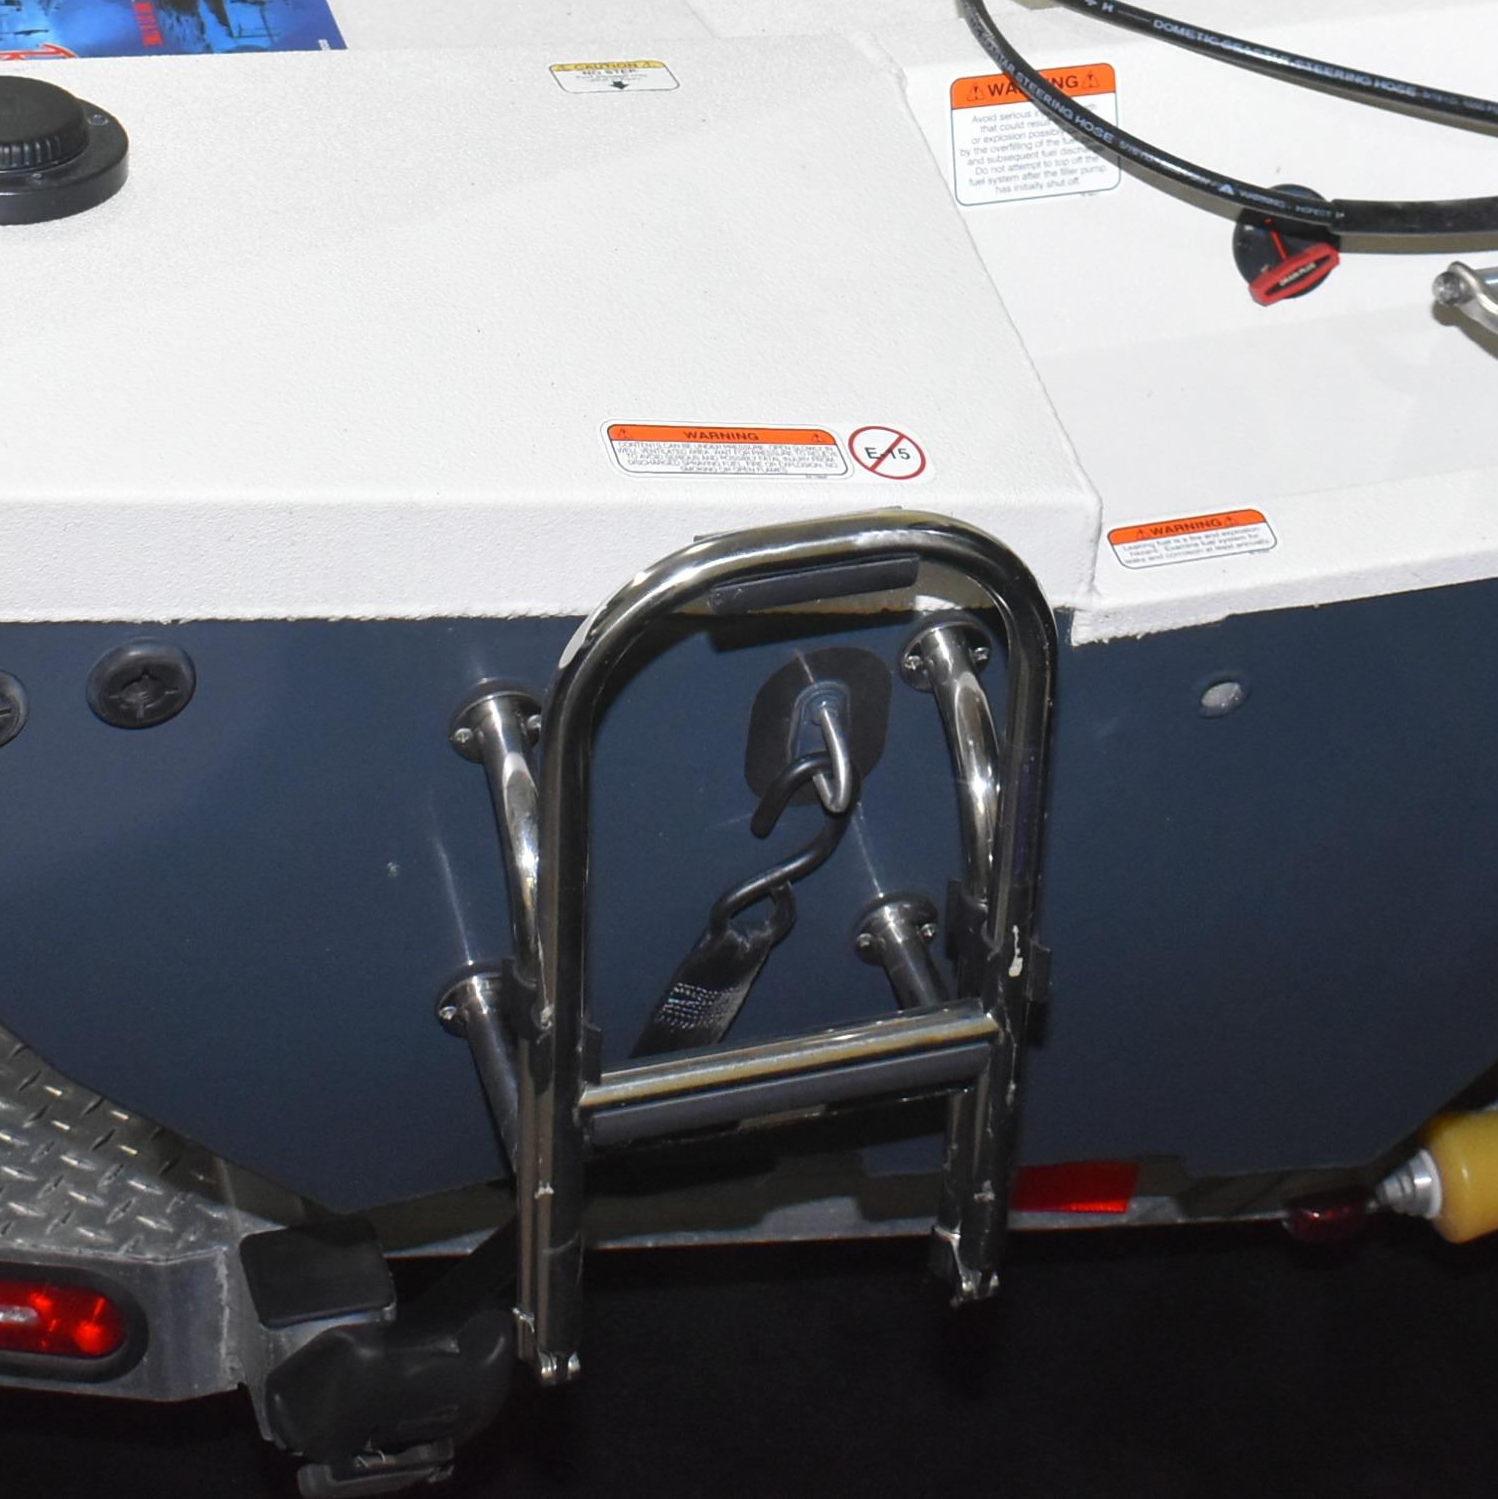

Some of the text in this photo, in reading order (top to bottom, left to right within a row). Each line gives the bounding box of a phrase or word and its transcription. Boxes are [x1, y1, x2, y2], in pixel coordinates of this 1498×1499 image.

[1015, 70, 1074, 120] STEERING
[1075, 114, 1116, 144] HOSE
[971, 113, 997, 123] Avoid
[979, 124, 997, 133] that
[999, 121, 1025, 131] could
[973, 146, 988, 155] the
[967, 156, 985, 166] and
[987, 150, 1039, 166] subsequent
[975, 166, 988, 175] Do
[991, 164, 1005, 174] not
[969, 177, 985, 186] fuel
[987, 173, 1019, 186] system
[995, 184, 1011, 193] has
[683, 430, 760, 441] WARNING
[864, 446, 912, 461] E-15
[1150, 517, 1222, 537] WARNING
